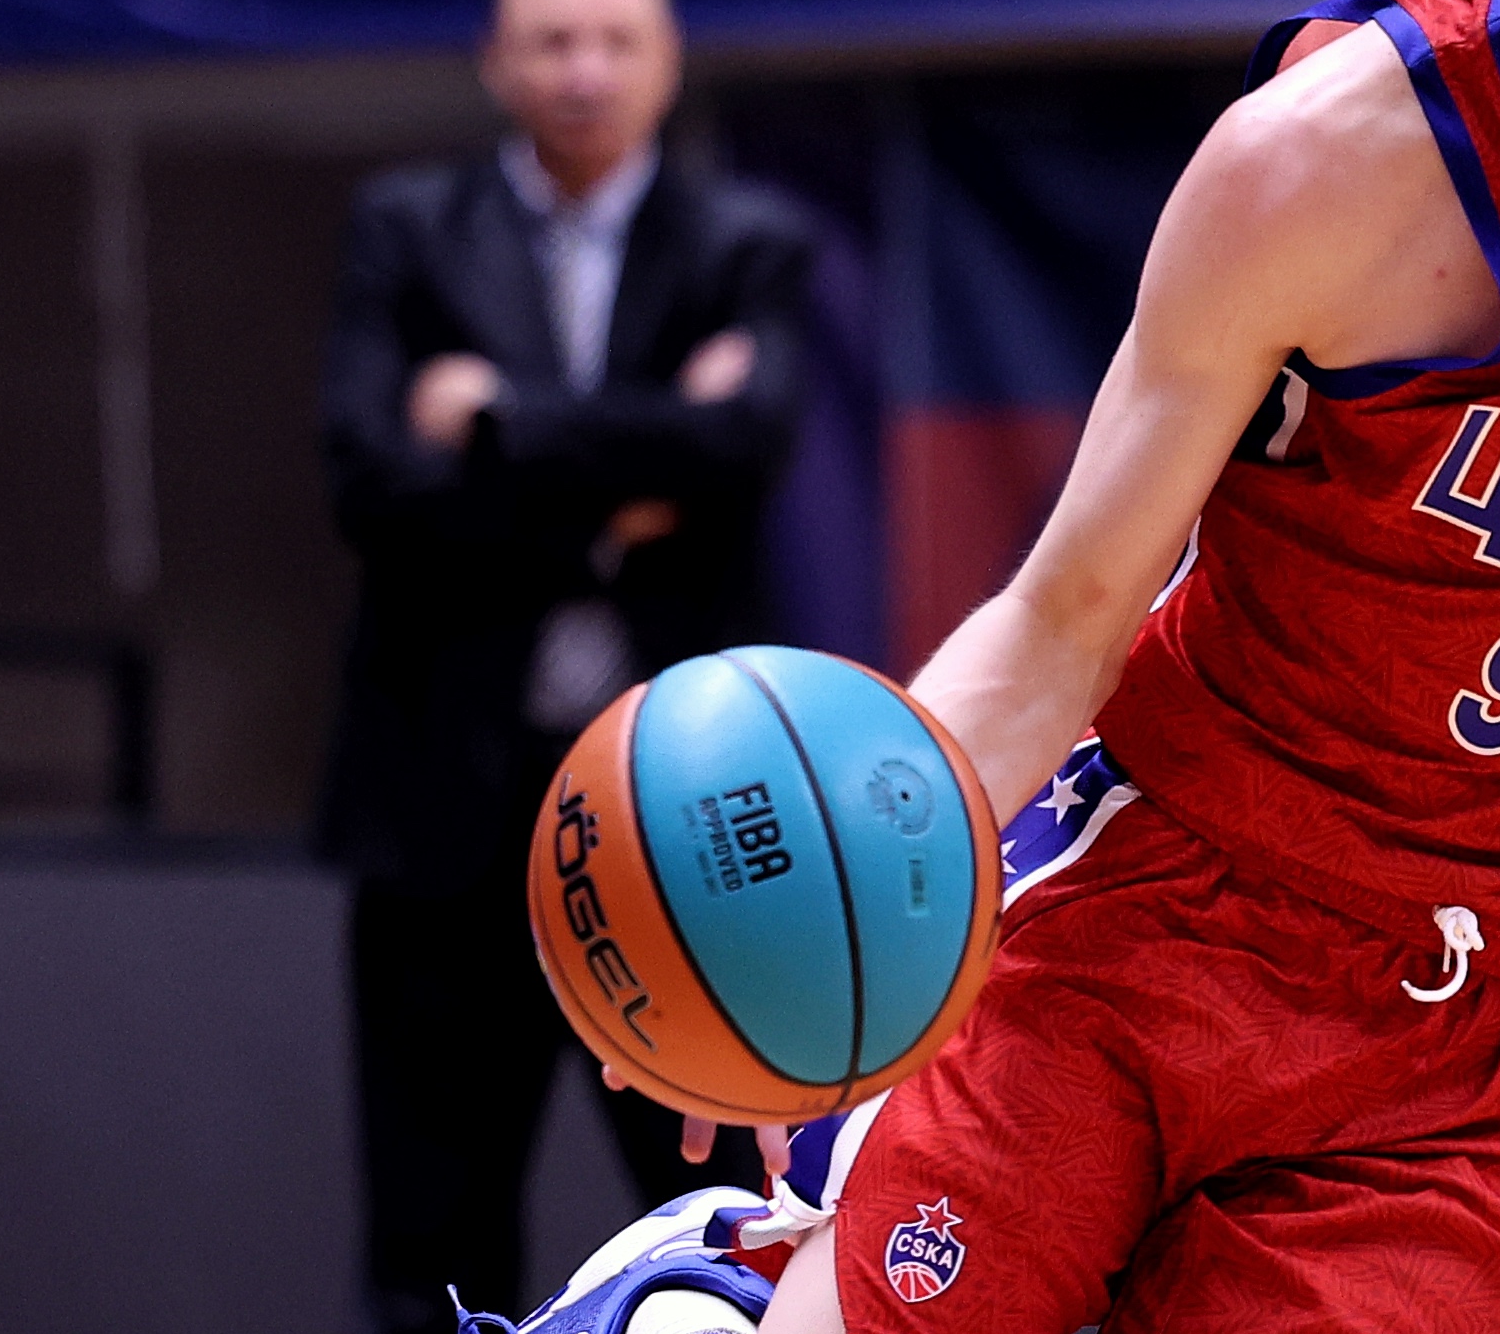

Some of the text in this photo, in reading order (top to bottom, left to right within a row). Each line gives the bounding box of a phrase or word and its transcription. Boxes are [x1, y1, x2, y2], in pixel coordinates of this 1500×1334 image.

[723, 780, 793, 883] FIBA
[556, 771, 660, 1053] JÖGEL
[895, 1233, 953, 1269] CSKA
